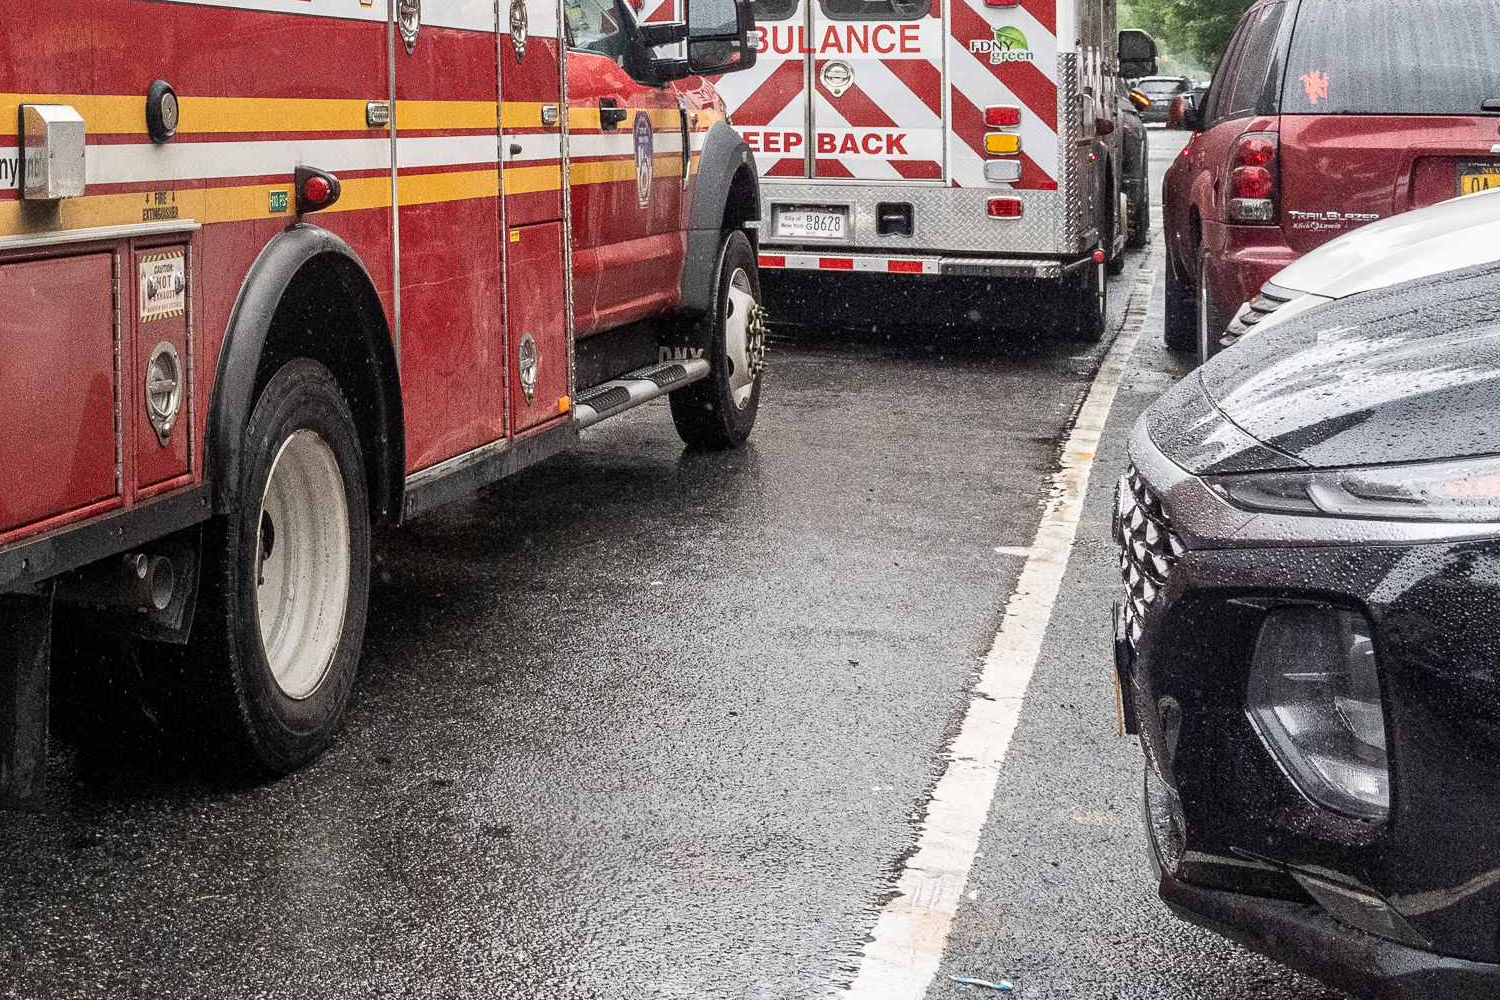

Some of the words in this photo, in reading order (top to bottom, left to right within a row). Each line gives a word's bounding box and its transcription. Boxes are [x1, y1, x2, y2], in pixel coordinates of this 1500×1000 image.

[755, 25, 921, 54] BULANCE
[972, 41, 1013, 51] FDNY
[992, 52, 1034, 63] green
[736, 132, 803, 152] EEP
[818, 133, 908, 155] BACK
[155, 192, 166, 205] FIRE
[143, 206, 178, 221] EXTINGUISHER
[814, 216, 840, 231] 8628
[157, 275, 171, 289] HOT
[154, 290, 175, 301] EXHAUST
